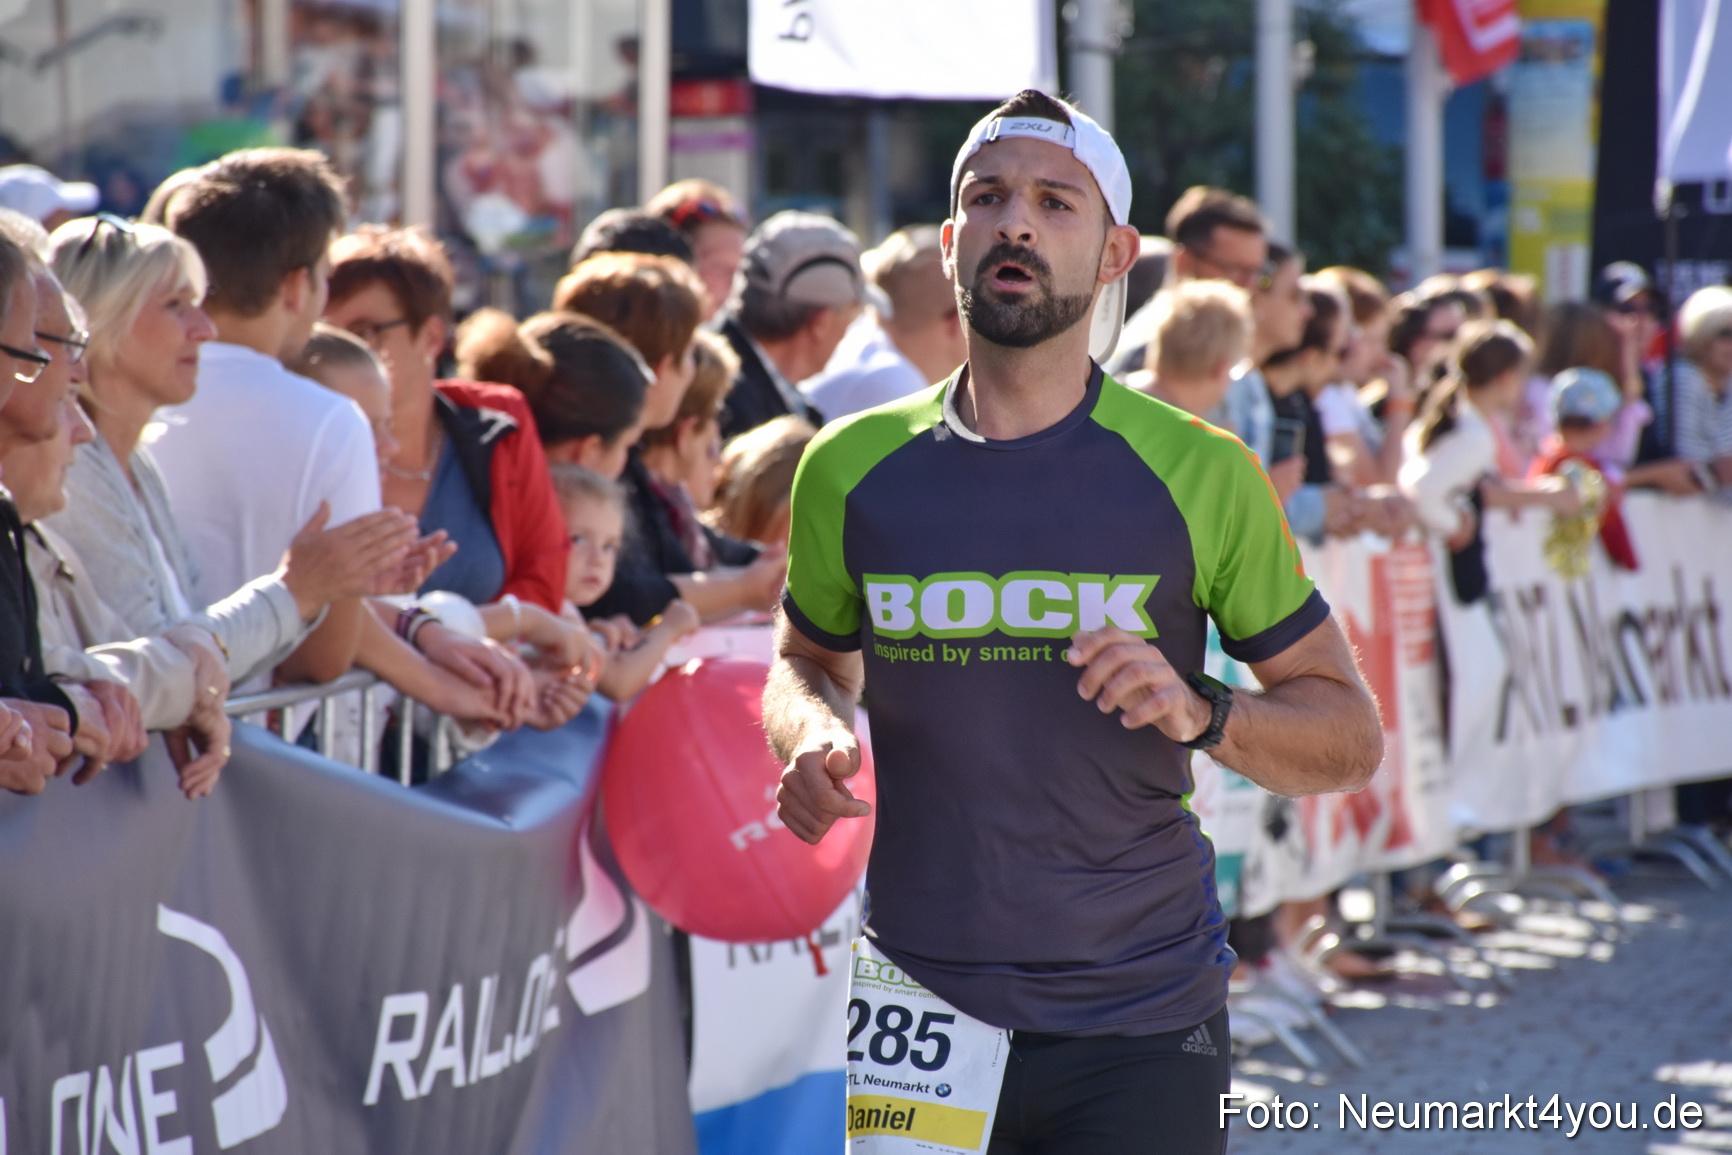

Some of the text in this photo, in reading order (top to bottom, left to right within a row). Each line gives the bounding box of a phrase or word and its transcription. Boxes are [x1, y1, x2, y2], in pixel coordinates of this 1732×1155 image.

[862, 571, 1161, 639] BOCK
[873, 638, 935, 664] inspired
[942, 643, 972, 666] by
[979, 644, 1053, 663] smart
[883, 984, 893, 993] by
[894, 987, 918, 998] smart
[846, 998, 956, 1072] 285
[1181, 1041, 1218, 1057] adidas
[863, 1074, 931, 1094] Neumarkt
